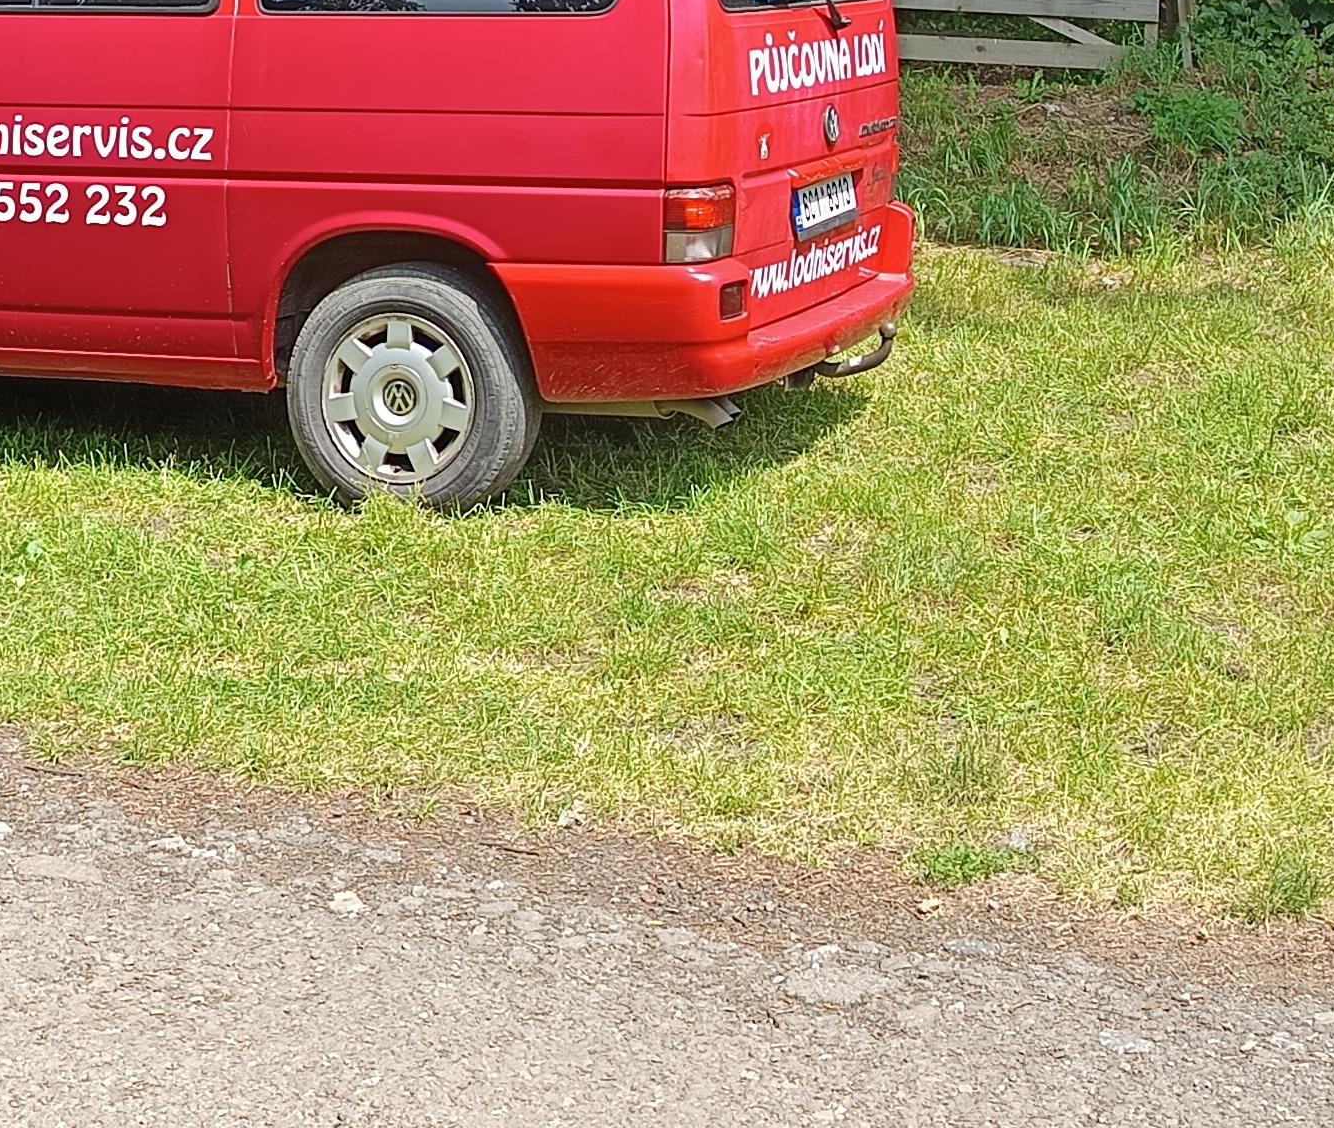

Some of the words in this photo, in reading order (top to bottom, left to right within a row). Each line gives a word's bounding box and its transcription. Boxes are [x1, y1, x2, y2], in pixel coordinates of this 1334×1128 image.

[748, 30, 852, 96] PŮJČOVNA
[854, 19, 886, 76] LODÍ
[85, 183, 167, 227] 232
